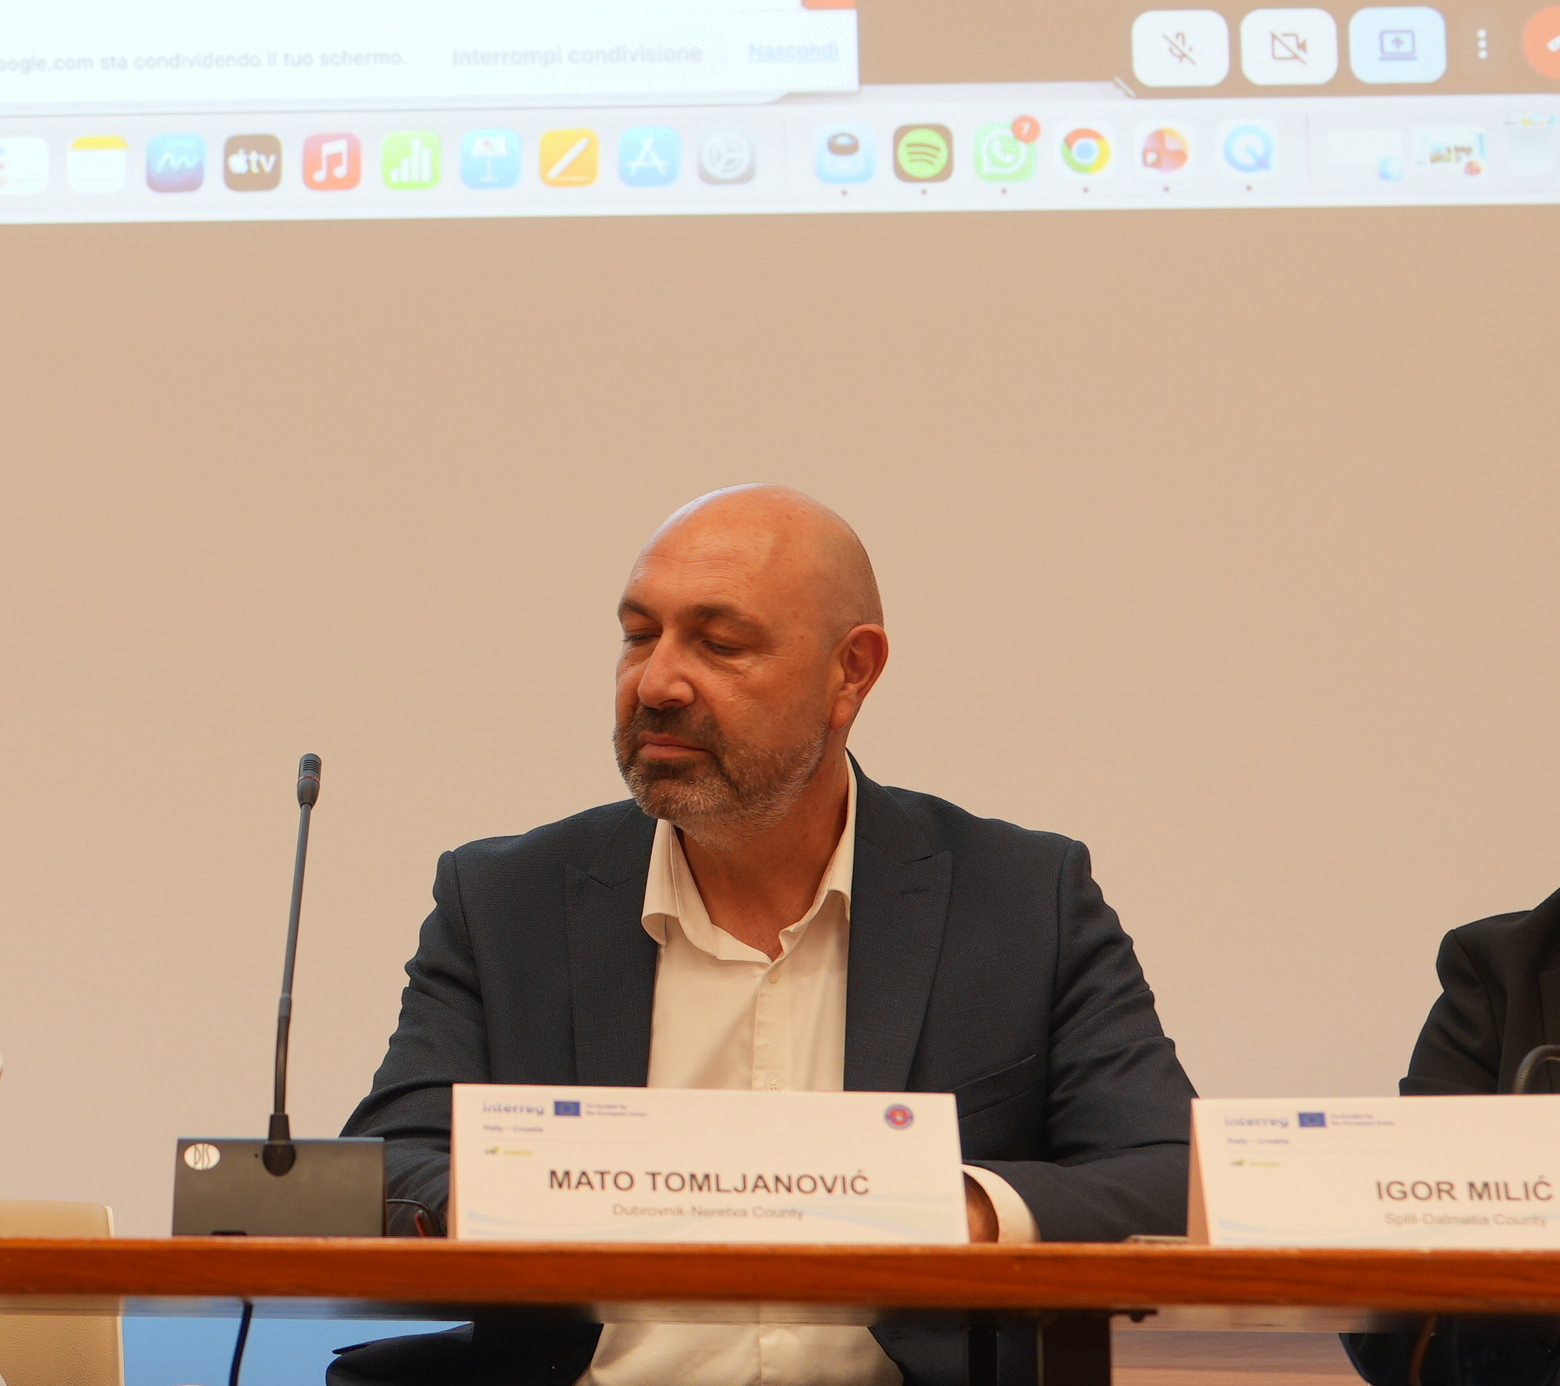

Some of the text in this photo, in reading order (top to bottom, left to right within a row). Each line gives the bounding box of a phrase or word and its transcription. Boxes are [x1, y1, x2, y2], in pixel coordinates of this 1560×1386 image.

[452, 41, 839, 68] Interrompi condivisione Nascondi
[548, 1169, 871, 1196] MATO TOMLJANOVIĆ
[1376, 1175, 1554, 1202] IGOR MILIĆ
[753, 1204, 804, 1221] County
[1494, 1213, 1547, 1228] County
